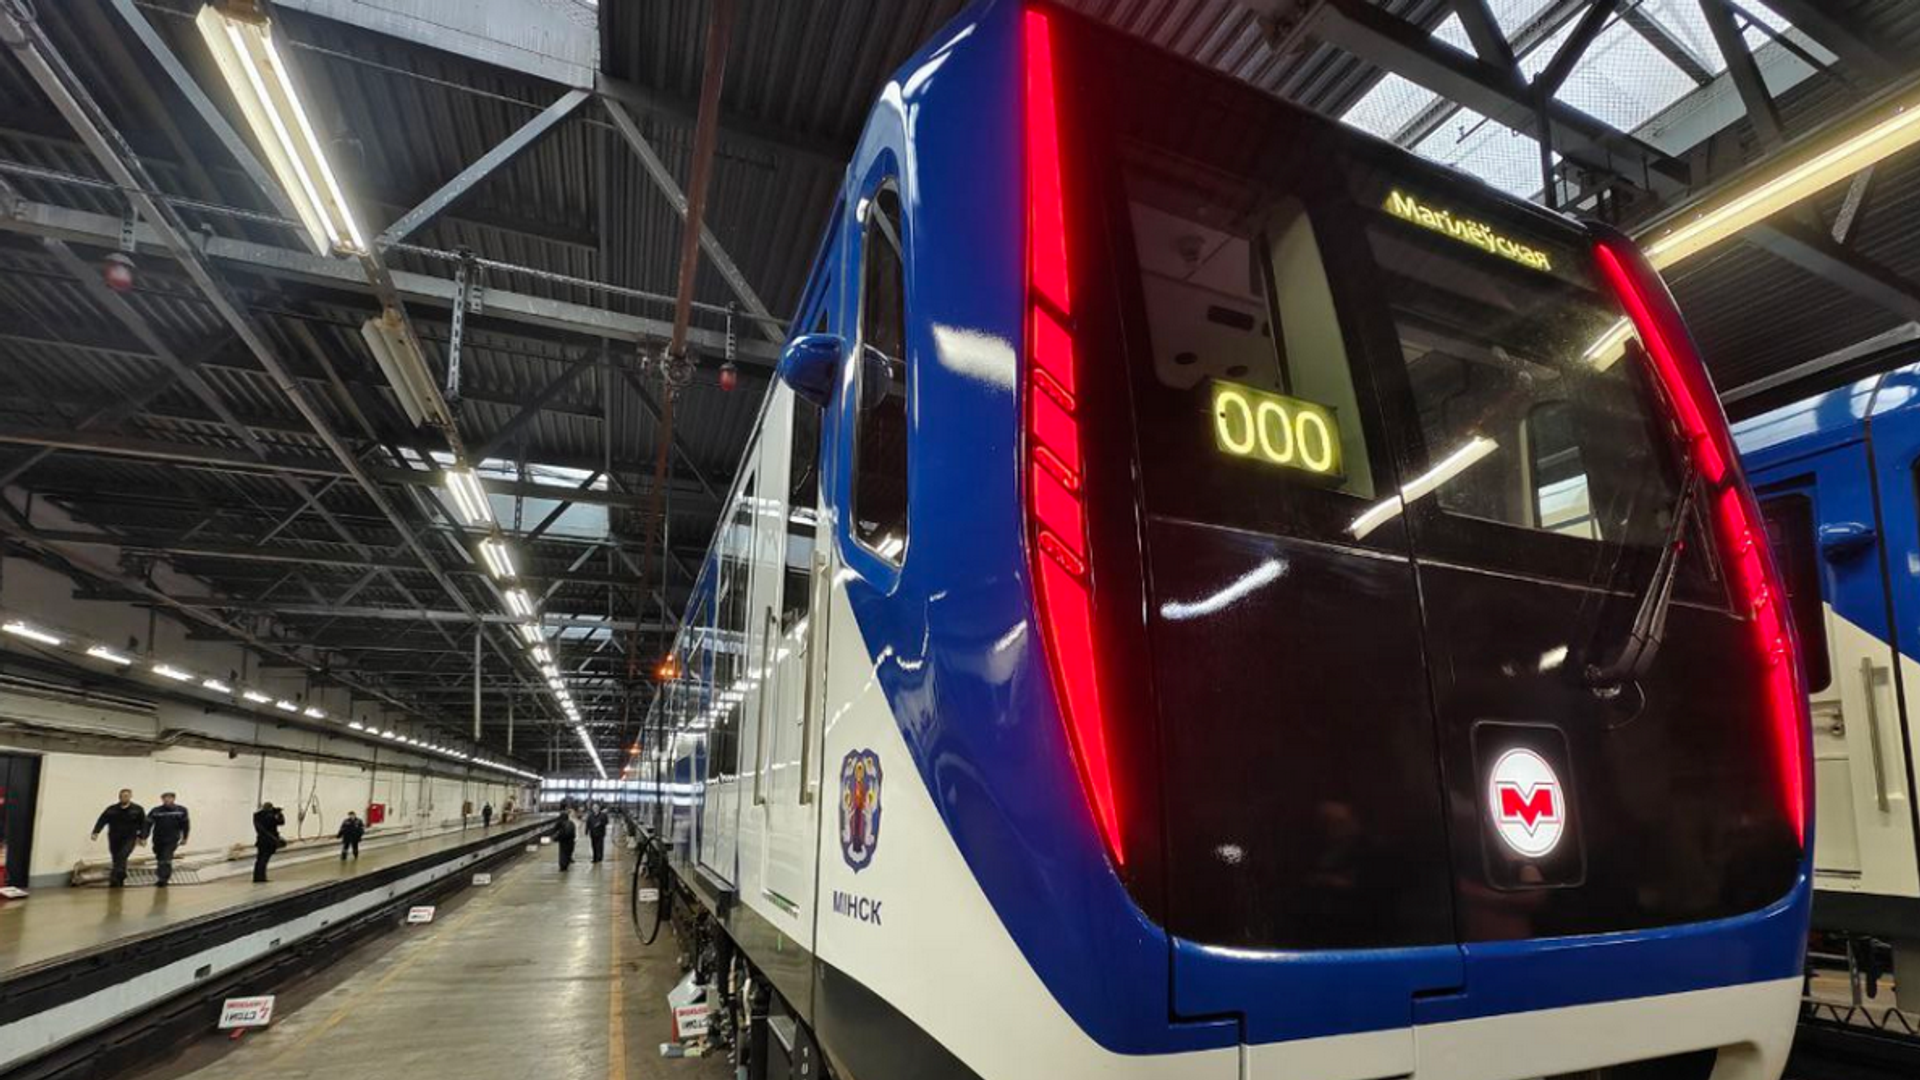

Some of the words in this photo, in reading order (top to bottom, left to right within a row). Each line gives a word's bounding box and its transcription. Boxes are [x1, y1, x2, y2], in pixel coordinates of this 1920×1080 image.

[1387, 190, 1551, 272] Магілёўская
[1216, 391, 1331, 472] 000
[1501, 787, 1554, 828] М
[833, 890, 882, 926] МІНСК
